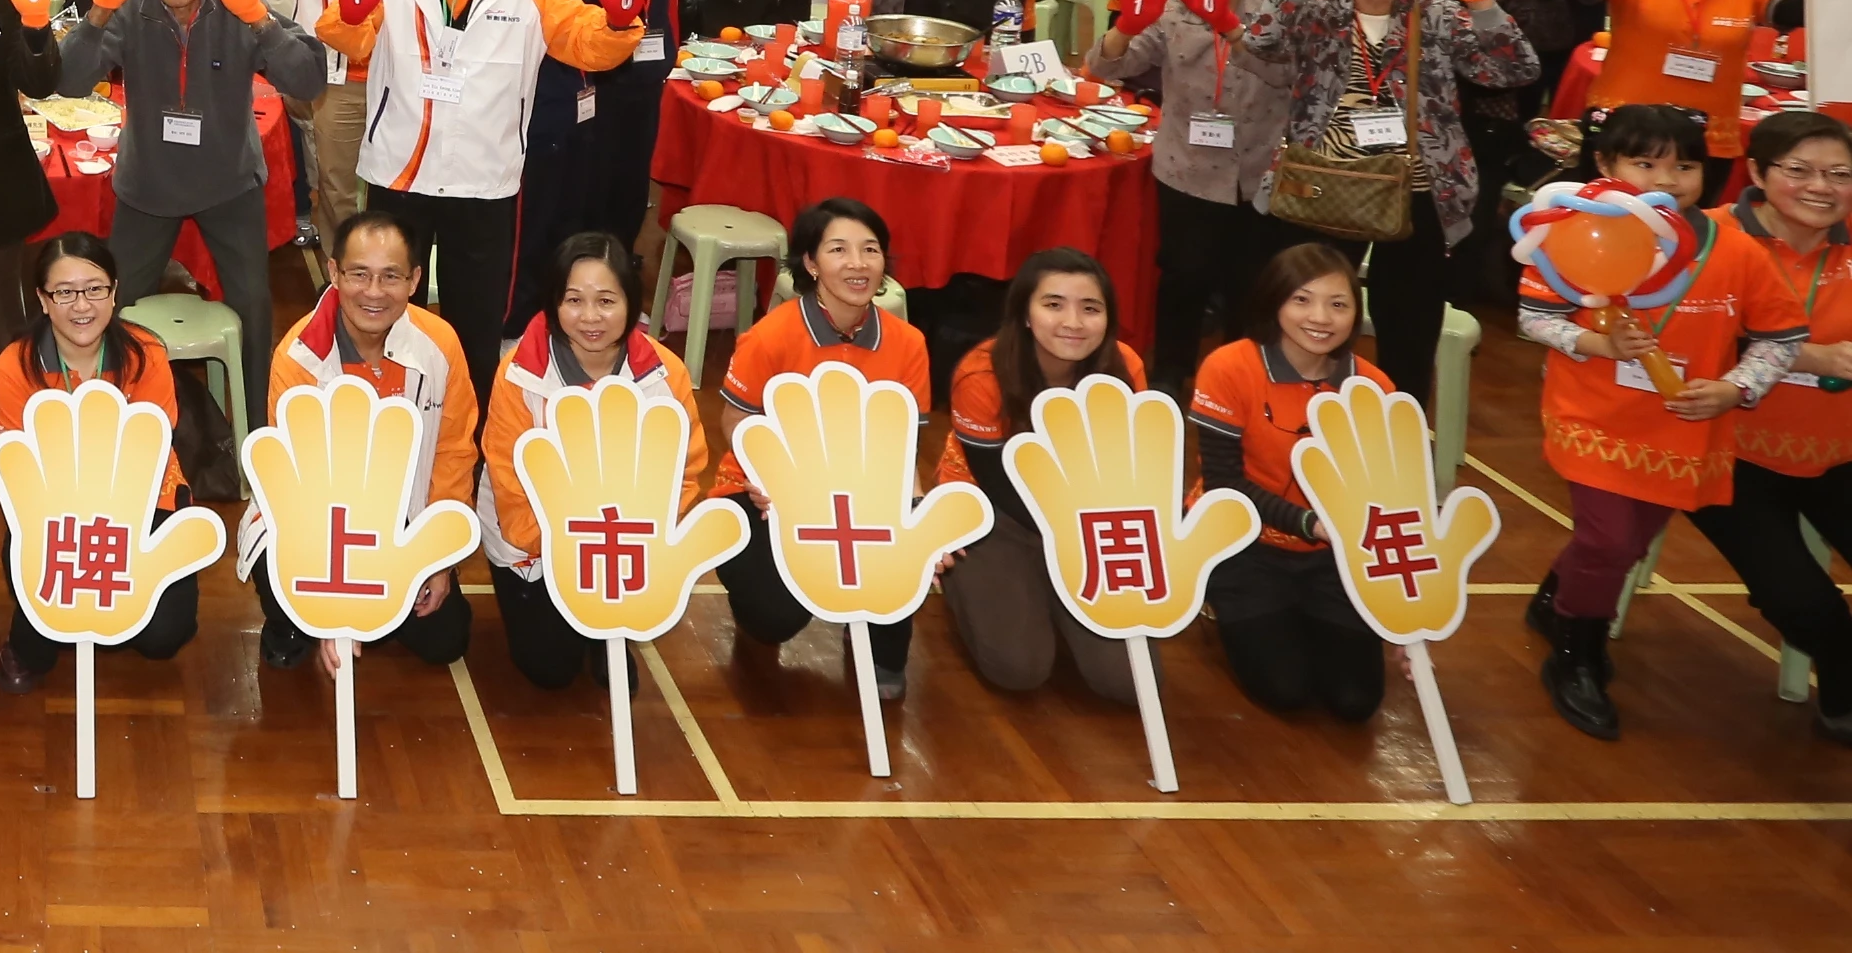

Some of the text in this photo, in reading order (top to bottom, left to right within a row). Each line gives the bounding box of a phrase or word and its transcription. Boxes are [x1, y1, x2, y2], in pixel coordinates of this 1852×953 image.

[1135, 0, 1142, 14] 1
[1019, 52, 1046, 75] 2B
[40, 517, 132, 608] 牌
[296, 507, 385, 596] 上
[568, 507, 655, 600] 市
[799, 495, 891, 586] 十
[1080, 509, 1167, 602] 周
[1361, 507, 1438, 598] 年
